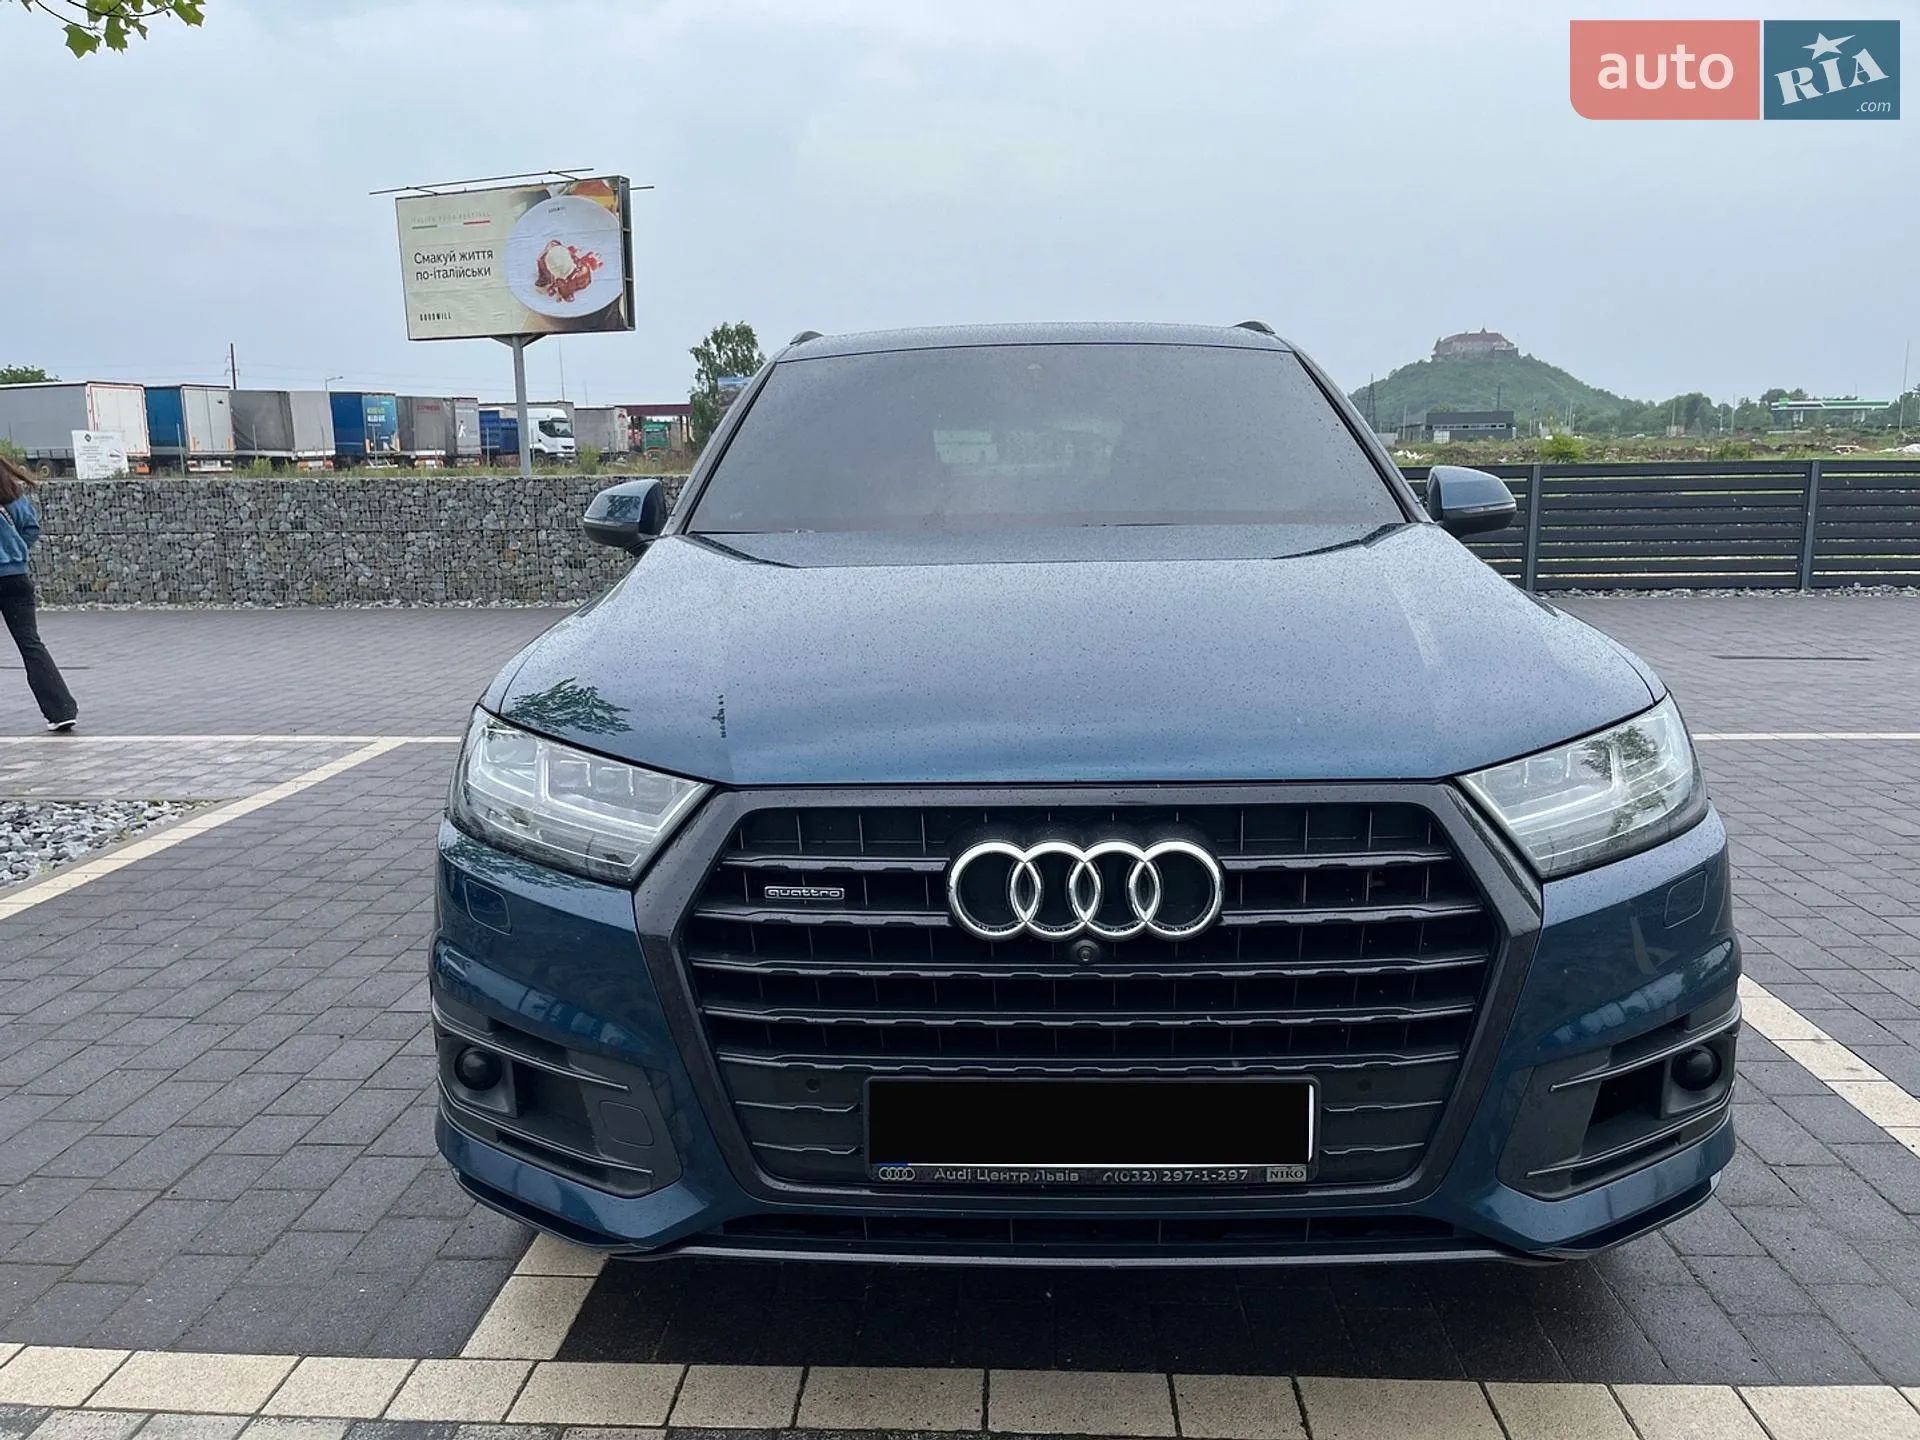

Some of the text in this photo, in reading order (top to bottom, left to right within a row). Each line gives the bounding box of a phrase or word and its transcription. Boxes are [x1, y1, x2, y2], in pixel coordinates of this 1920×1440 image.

[413, 249, 494, 266] Смакуй життя
[415, 266, 492, 281] по-італійськи
[767, 889, 840, 899] quattro
[933, 1167, 1080, 1183] Audi Центр Львів
[1162, 1168, 1249, 1182] 297-1-297
[1269, 1169, 1305, 1180] NIKO
